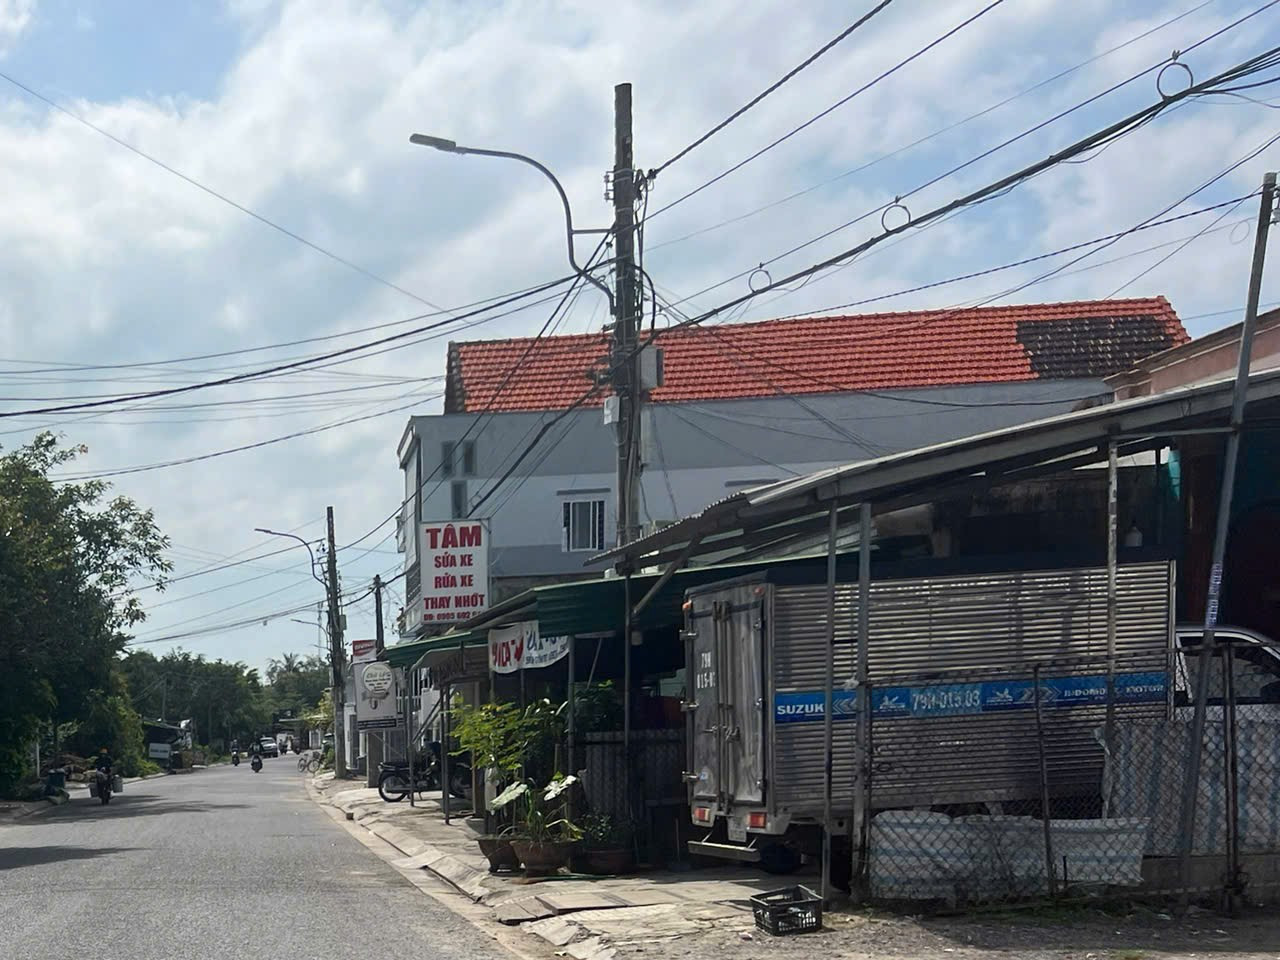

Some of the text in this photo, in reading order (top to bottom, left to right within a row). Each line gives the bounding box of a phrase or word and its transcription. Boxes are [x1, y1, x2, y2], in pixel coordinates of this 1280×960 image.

[426, 523, 482, 549] TÂM
[434, 551, 473, 568] SỬA XE
[434, 572, 473, 589] RỬA XE
[424, 592, 485, 609] THAY NHỚT
[777, 703, 825, 715] SUZUK
